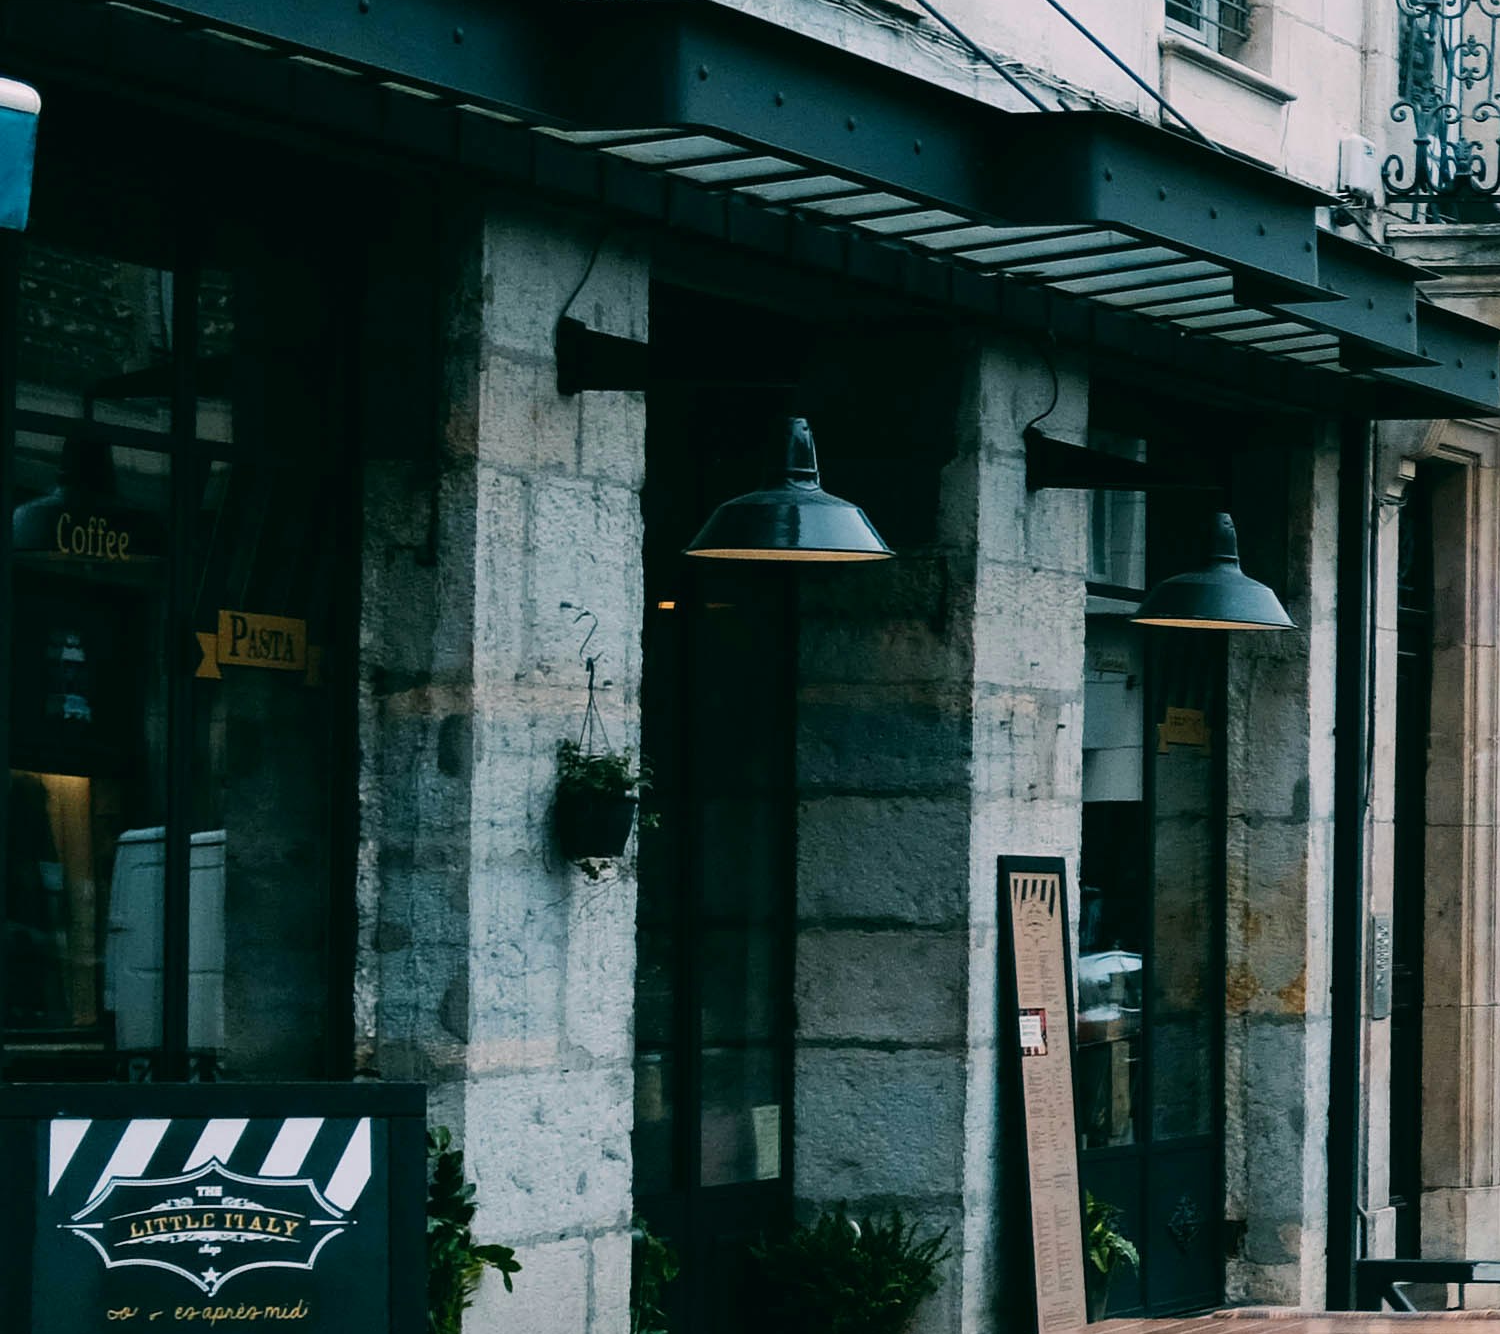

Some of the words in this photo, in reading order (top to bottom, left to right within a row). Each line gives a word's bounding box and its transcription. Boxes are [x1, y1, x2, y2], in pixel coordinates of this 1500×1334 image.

[56, 512, 132, 561] Coffee
[196, 1185, 223, 1197] THE
[129, 1213, 215, 1239] LITTLE
[224, 1213, 299, 1238] ITALY
